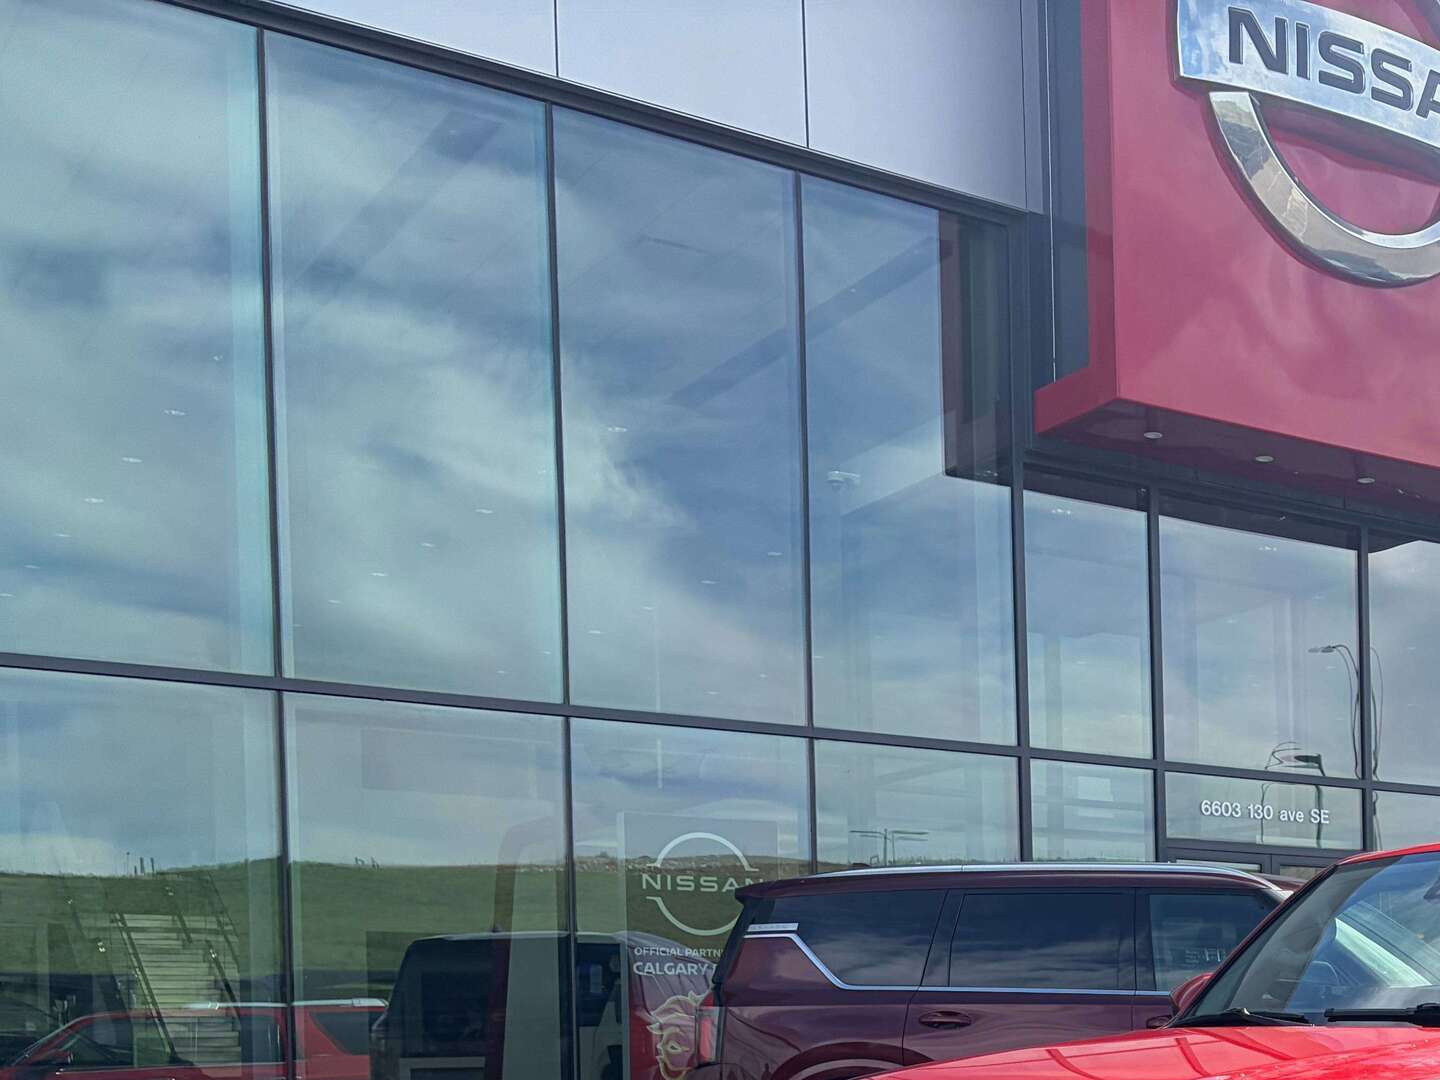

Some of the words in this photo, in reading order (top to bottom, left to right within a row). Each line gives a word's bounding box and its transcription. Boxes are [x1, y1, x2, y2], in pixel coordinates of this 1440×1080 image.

[1201, 799, 1242, 818] 6603
[1247, 803, 1274, 820] 130
[1279, 808, 1305, 823] ave
[1310, 808, 1330, 824] SE
[634, 946, 683, 956] OFFICIAL
[684, 948, 723, 958] PARTN
[632, 962, 709, 976] CALGARY
